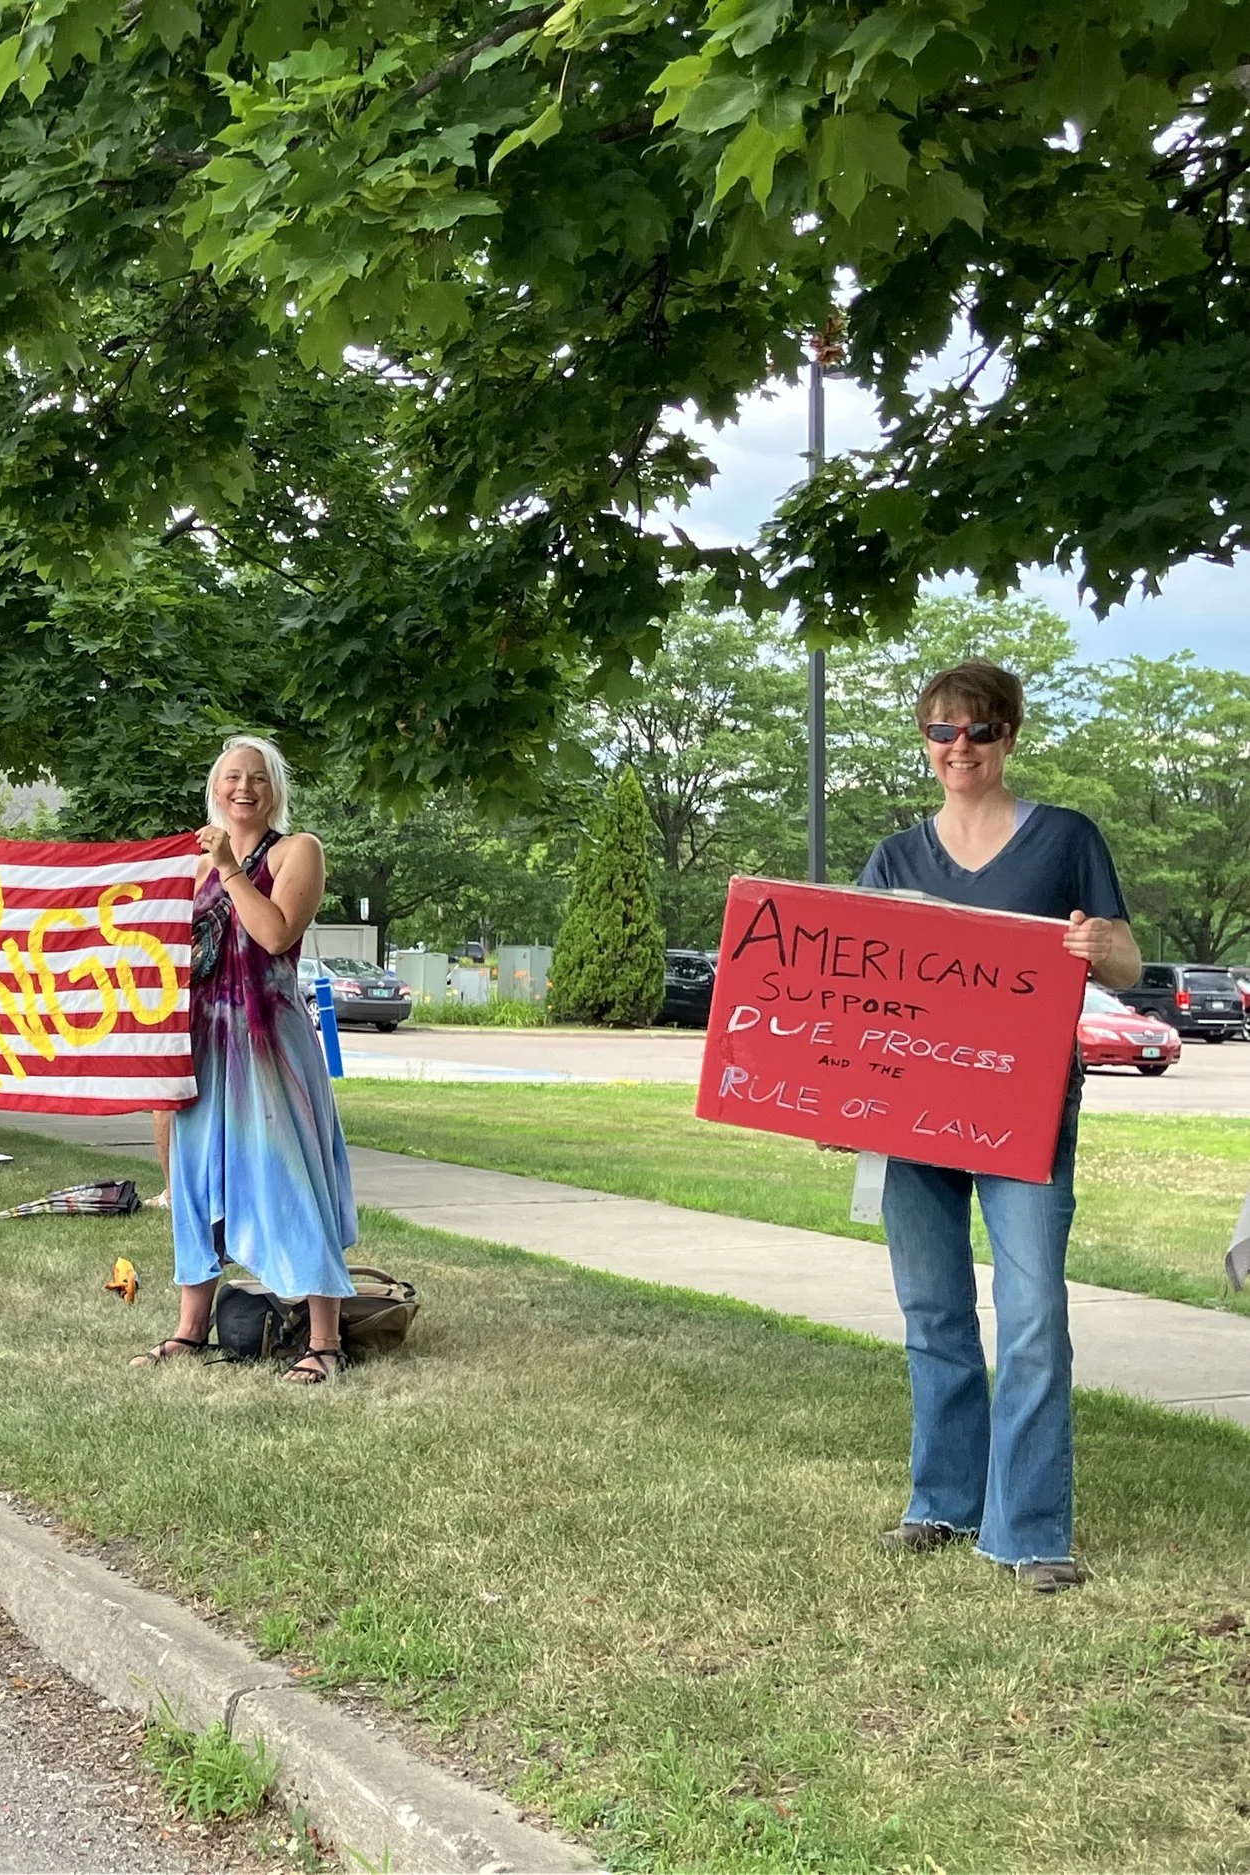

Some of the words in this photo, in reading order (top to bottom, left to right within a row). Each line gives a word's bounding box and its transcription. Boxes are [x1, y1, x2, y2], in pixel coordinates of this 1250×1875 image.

[731, 898, 1039, 995] AMERICANS
[756, 971, 930, 1021] SUPPORT
[727, 1005, 836, 1045] DUE
[859, 1030, 1016, 1074] PROCESS
[817, 1055, 851, 1068] AND
[869, 1062, 906, 1079] THE
[718, 1065, 821, 1116] RULE
[840, 1097, 890, 1120] OF
[912, 1109, 1015, 1150] LAW
